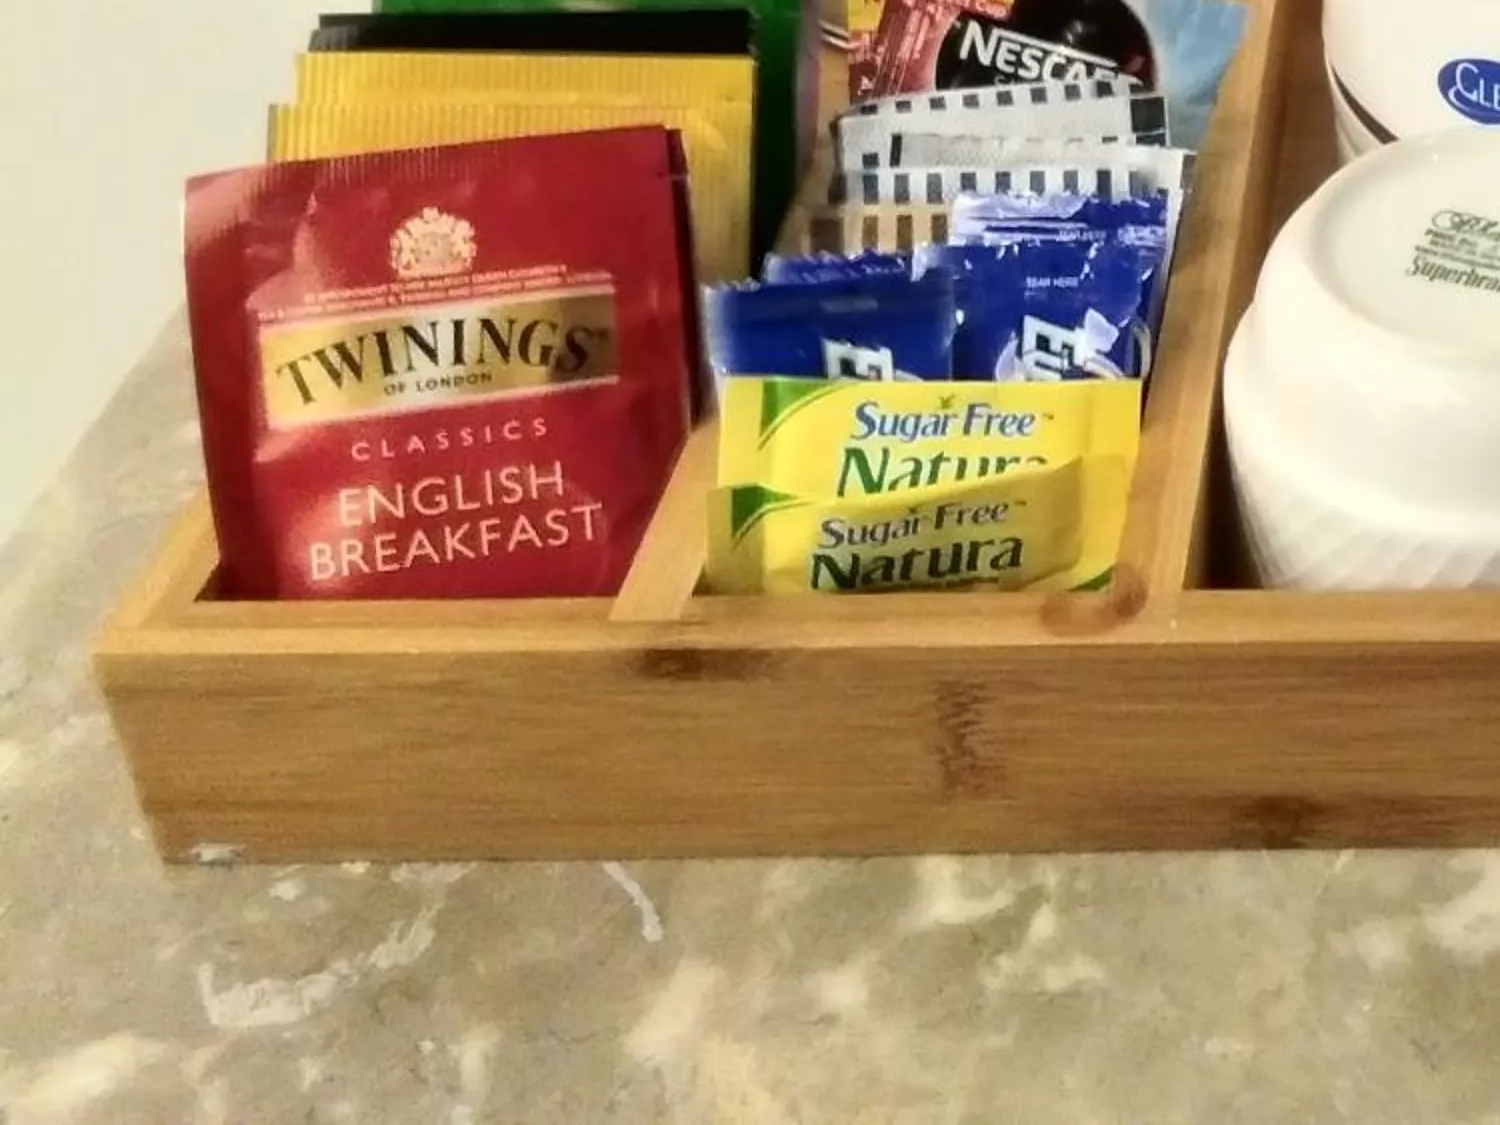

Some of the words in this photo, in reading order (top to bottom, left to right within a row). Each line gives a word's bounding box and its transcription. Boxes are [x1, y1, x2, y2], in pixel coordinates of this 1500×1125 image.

[958, 19, 1120, 83] NESCA
[275, 316, 594, 407] TWININGS
[383, 381, 405, 396] OF
[416, 372, 493, 392] LONDON
[350, 417, 548, 461] CLASSICS
[850, 401, 958, 443] Sugar
[962, 402, 1036, 437] Free
[337, 459, 564, 527] ENGLISH
[309, 500, 603, 581] BREAKFAST
[817, 512, 931, 550] Sugar
[932, 500, 1010, 531] Free
[810, 535, 1024, 591] Natura
